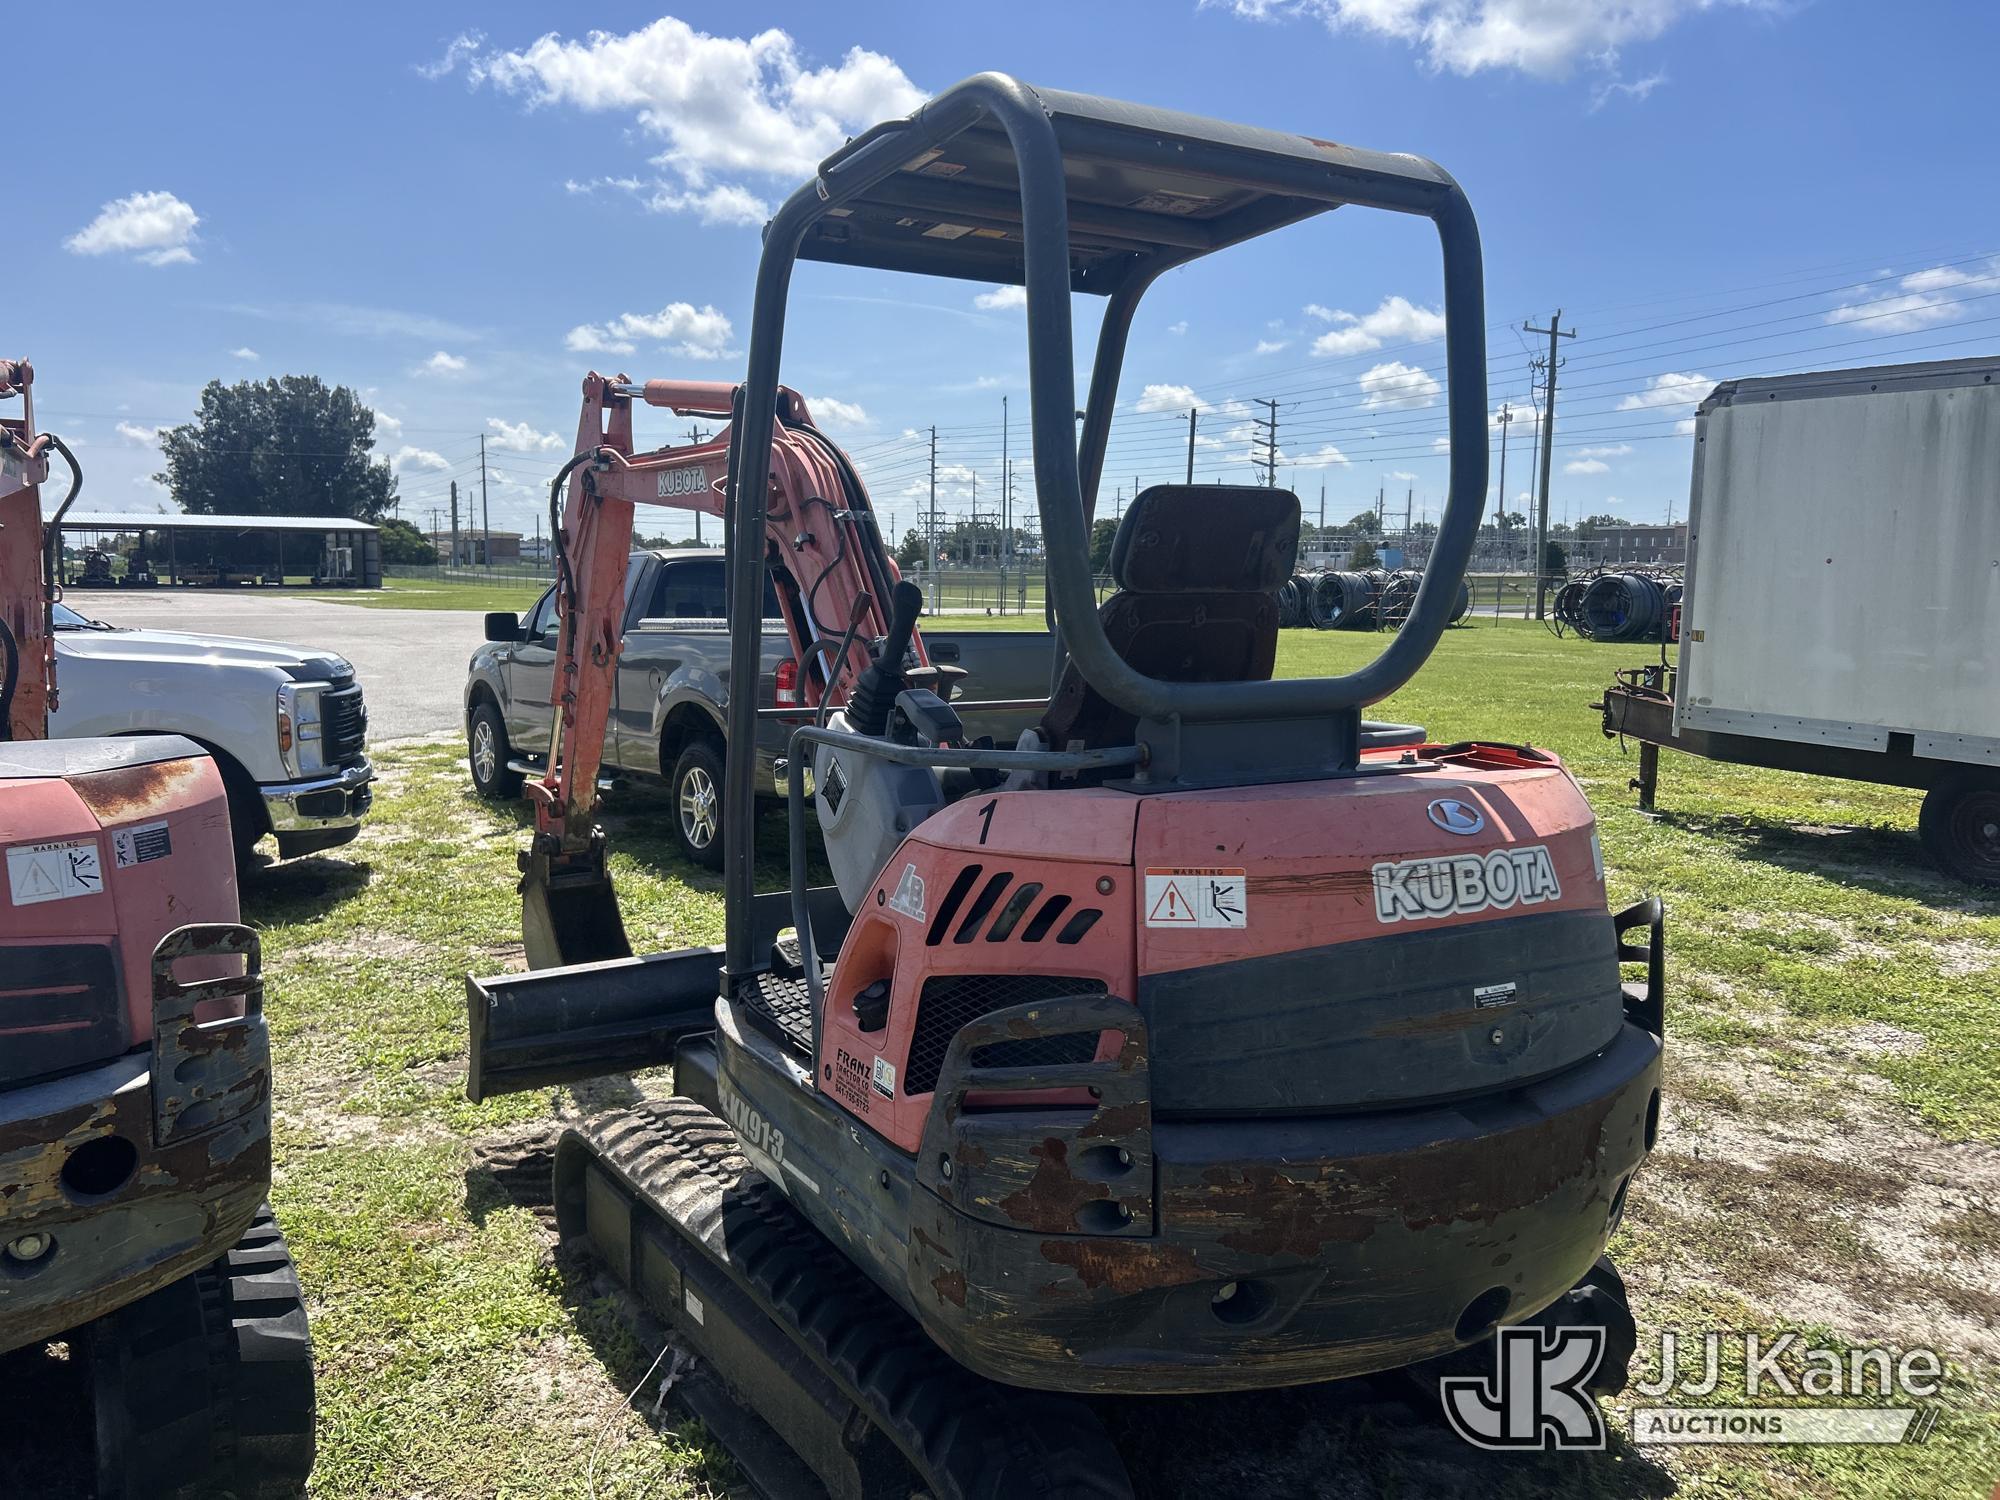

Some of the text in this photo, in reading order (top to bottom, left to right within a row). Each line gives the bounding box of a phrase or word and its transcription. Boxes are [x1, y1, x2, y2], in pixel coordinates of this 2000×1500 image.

[658, 467, 707, 496] KUBOTA
[979, 799, 998, 845] 1
[32, 841, 79, 852] WARNING
[1172, 868, 1224, 876] WARNING
[1375, 848, 1560, 918] KUBOTA
[836, 1048, 871, 1080] FRANZ
[836, 1062, 861, 1085] TRACTOR
